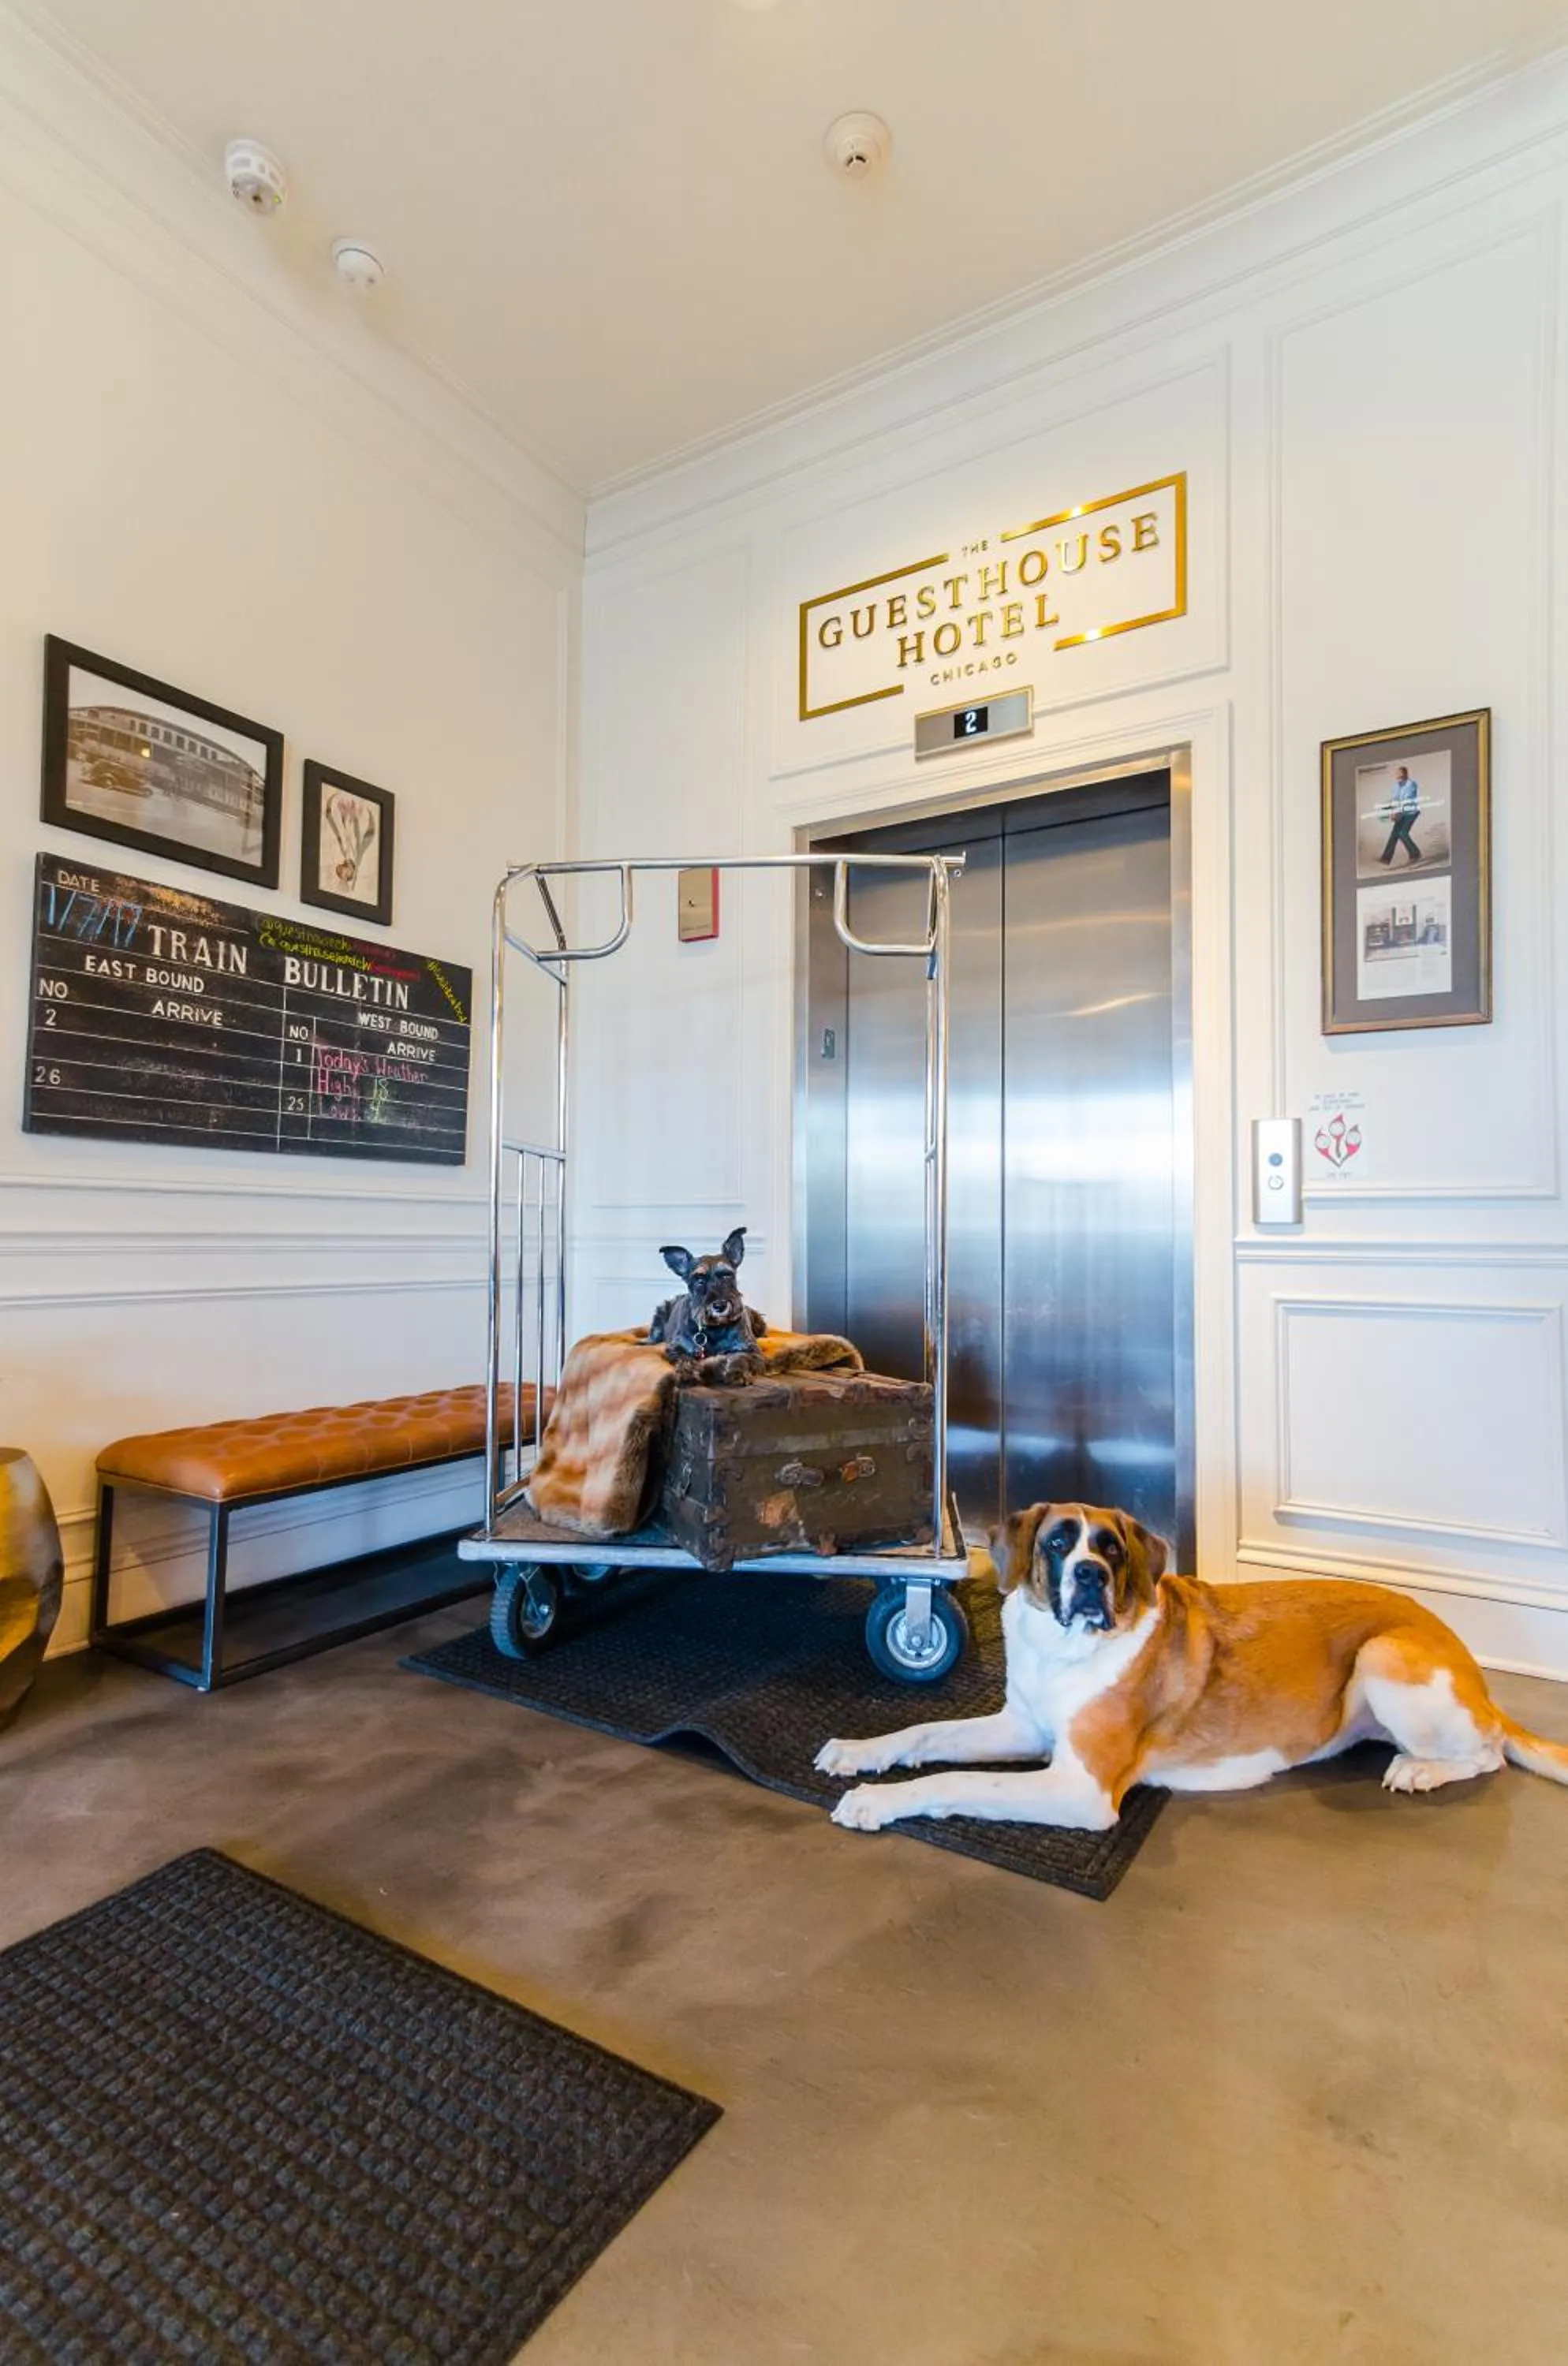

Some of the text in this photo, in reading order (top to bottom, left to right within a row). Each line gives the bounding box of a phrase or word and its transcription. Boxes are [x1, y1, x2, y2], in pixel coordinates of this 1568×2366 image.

[961, 539, 989, 556] THE
[818, 512, 1160, 648] GUESTHOUSE
[896, 593, 1060, 669] HOTEL
[930, 651, 1017, 685] CHICAGO
[965, 711, 977, 733] 2
[58, 870, 100, 893] DATE
[84, 955, 204, 993] EAST BOUND
[147, 925, 248, 975] TRAIN
[284, 956, 409, 1010] BULLETIN
[39, 978, 68, 999] NO
[45, 1009, 57, 1026] 2
[151, 1000, 224, 1026] ARRIVE
[289, 1025, 308, 1039] NO
[358, 1012, 439, 1040] WEST BOUND
[296, 1048, 301, 1062] 1
[387, 1042, 436, 1062] ARRIVE
[35, 1066, 62, 1085] 26
[287, 1096, 304, 1111] 25
